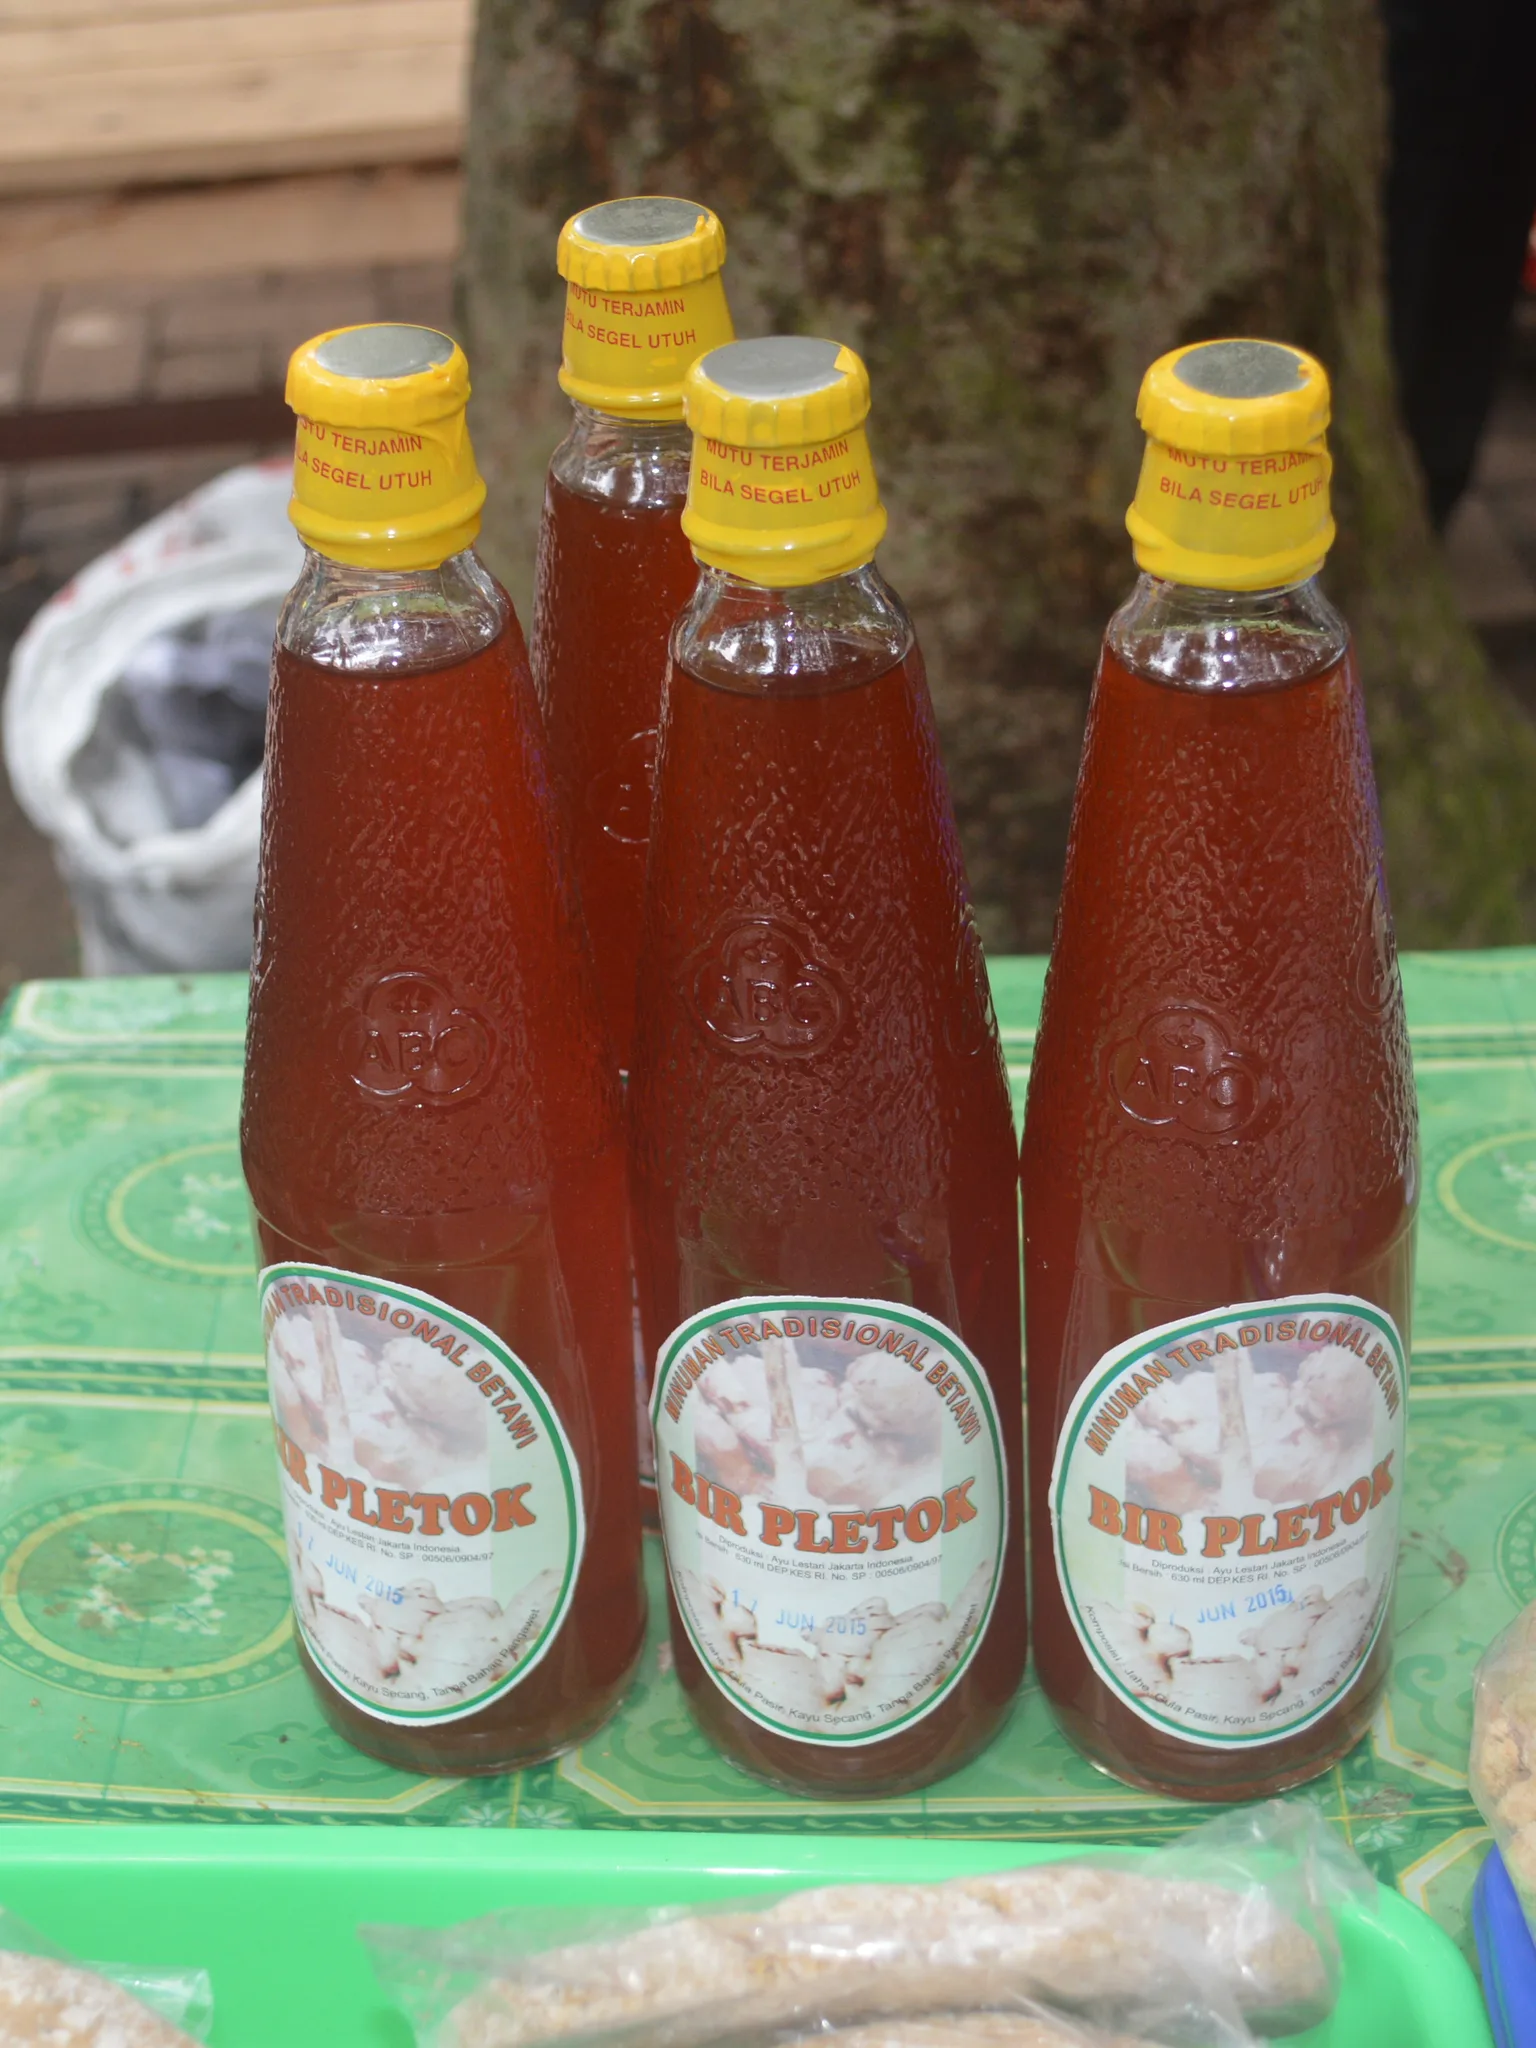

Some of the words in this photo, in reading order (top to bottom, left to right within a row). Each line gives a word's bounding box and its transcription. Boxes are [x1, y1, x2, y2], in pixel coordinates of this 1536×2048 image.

[602, 298, 685, 317] TERJAMIN
[587, 325, 642, 349] SEGEL
[648, 329, 697, 348] UTUH
[331, 431, 423, 456] TERJAMIN
[706, 438, 752, 467] MUTU
[760, 439, 849, 472] TERJAMIN
[312, 457, 372, 490] SEGEL
[379, 469, 432, 490] UTUH
[1168, 447, 1227, 473] MUTU
[700, 469, 735, 496] BILA
[740, 484, 813, 504] SEGEL
[818, 469, 861, 498] UTUH
[1160, 476, 1202, 504] BILA
[1209, 490, 1281, 510] SEGEL
[280, 1283, 469, 1367] TRADISIONAL
[465, 1360, 539, 1449] BETAWI
[664, 1333, 725, 1424] MINUMAN
[718, 1316, 930, 1372] TRADISIONAL
[925, 1360, 981, 1445] BETAWI
[1084, 1359, 1172, 1456] MINUMAN
[1165, 1319, 1371, 1368] TRADISIONAL
[317, 1463, 537, 1537] PLETOK
[669, 1450, 747, 1537] BIR
[758, 1476, 979, 1554] PLETOK
[1088, 1484, 1187, 1556] BIR
[1200, 1449, 1395, 1558] PLETOK
[378, 1537, 411, 1550] Jakarta
[413, 1543, 460, 1553] Indonesia
[771, 1555, 790, 1567] Ayu
[828, 1562, 864, 1571] Jakarta
[867, 1555, 914, 1569] Indonesia
[831, 1572, 848, 1580] No.
[851, 1571, 866, 1580] SP
[1151, 1559, 1204, 1574] Diproduksi
[1213, 1566, 1232, 1576] Ayu
[1270, 1555, 1305, 1570] Jakarta
[1171, 1573, 1190, 1582] 630
[1273, 1569, 1290, 1578] No.
[326, 1553, 357, 1584] JUN
[364, 1574, 404, 1605] 2015
[776, 1608, 815, 1632] JUN
[825, 1615, 867, 1636] 2015
[1197, 1601, 1237, 1624] JUN
[788, 1708, 820, 1722] Kayu
[1223, 1714, 1256, 1726] Kayu
